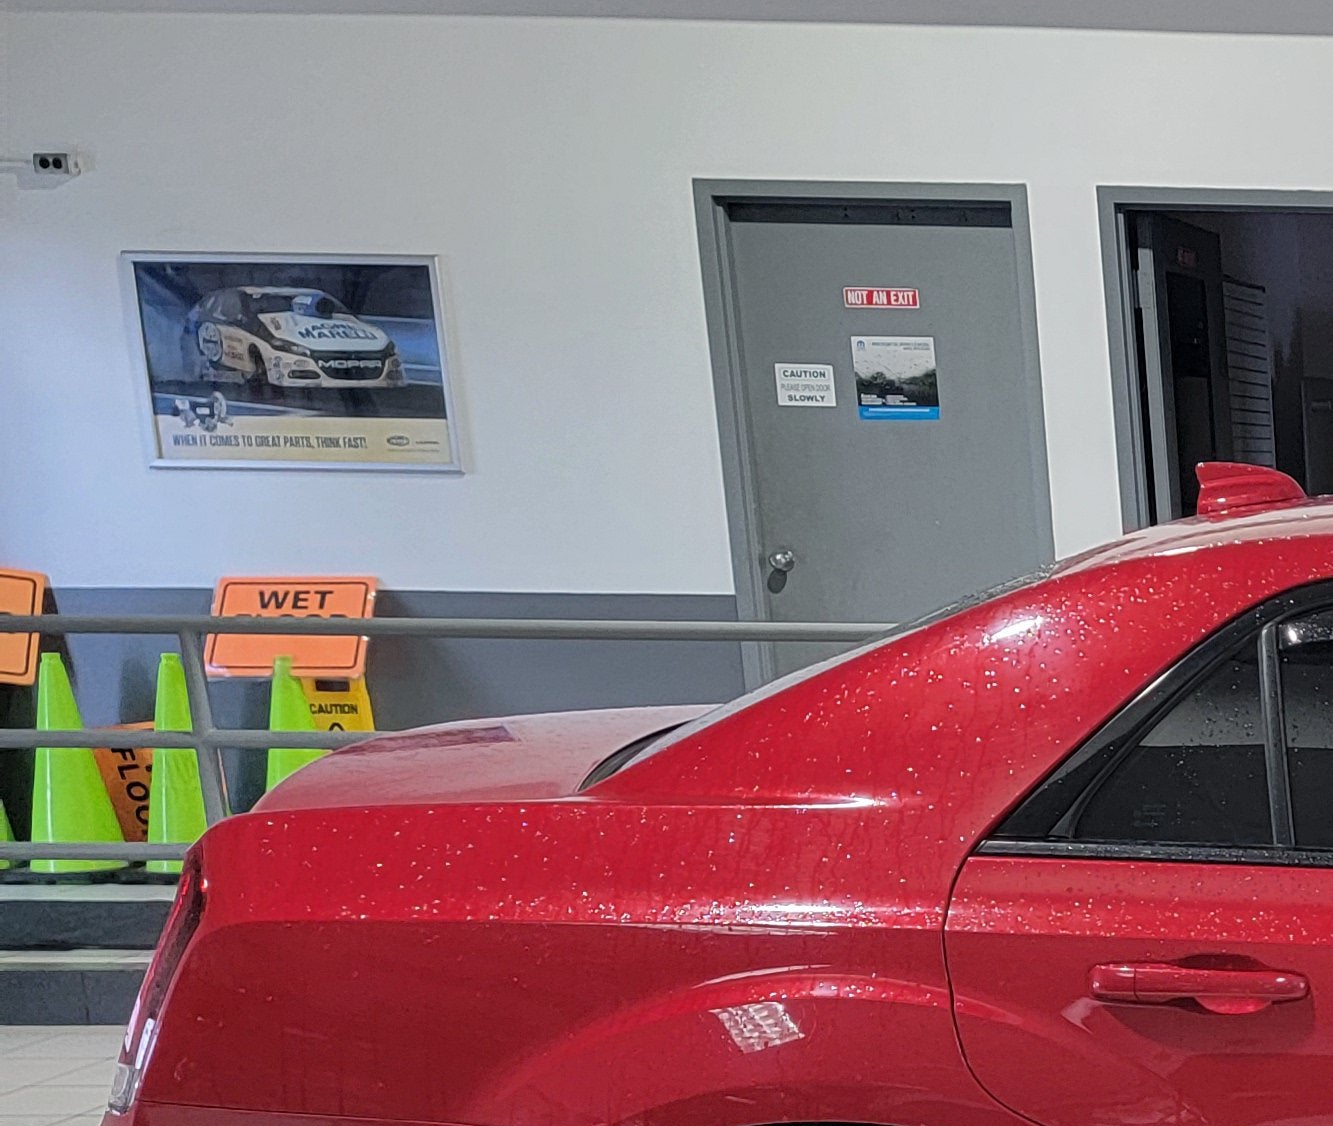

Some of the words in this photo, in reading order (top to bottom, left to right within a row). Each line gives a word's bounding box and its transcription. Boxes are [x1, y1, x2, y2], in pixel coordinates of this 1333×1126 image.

[847, 290, 868, 305] NOT
[872, 291, 887, 305] AN
[890, 291, 915, 306] EXIT
[782, 369, 826, 379] CAUTION
[787, 394, 826, 403] SLOWLY
[173, 434, 198, 447] WHEN
[199, 435, 207, 447] IT
[209, 434, 240, 447] COMES
[241, 435, 252, 447] TO
[254, 435, 281, 448] GREAT
[315, 436, 341, 449] THINK
[258, 590, 334, 610] WET
[309, 703, 358, 715] CAUTION
